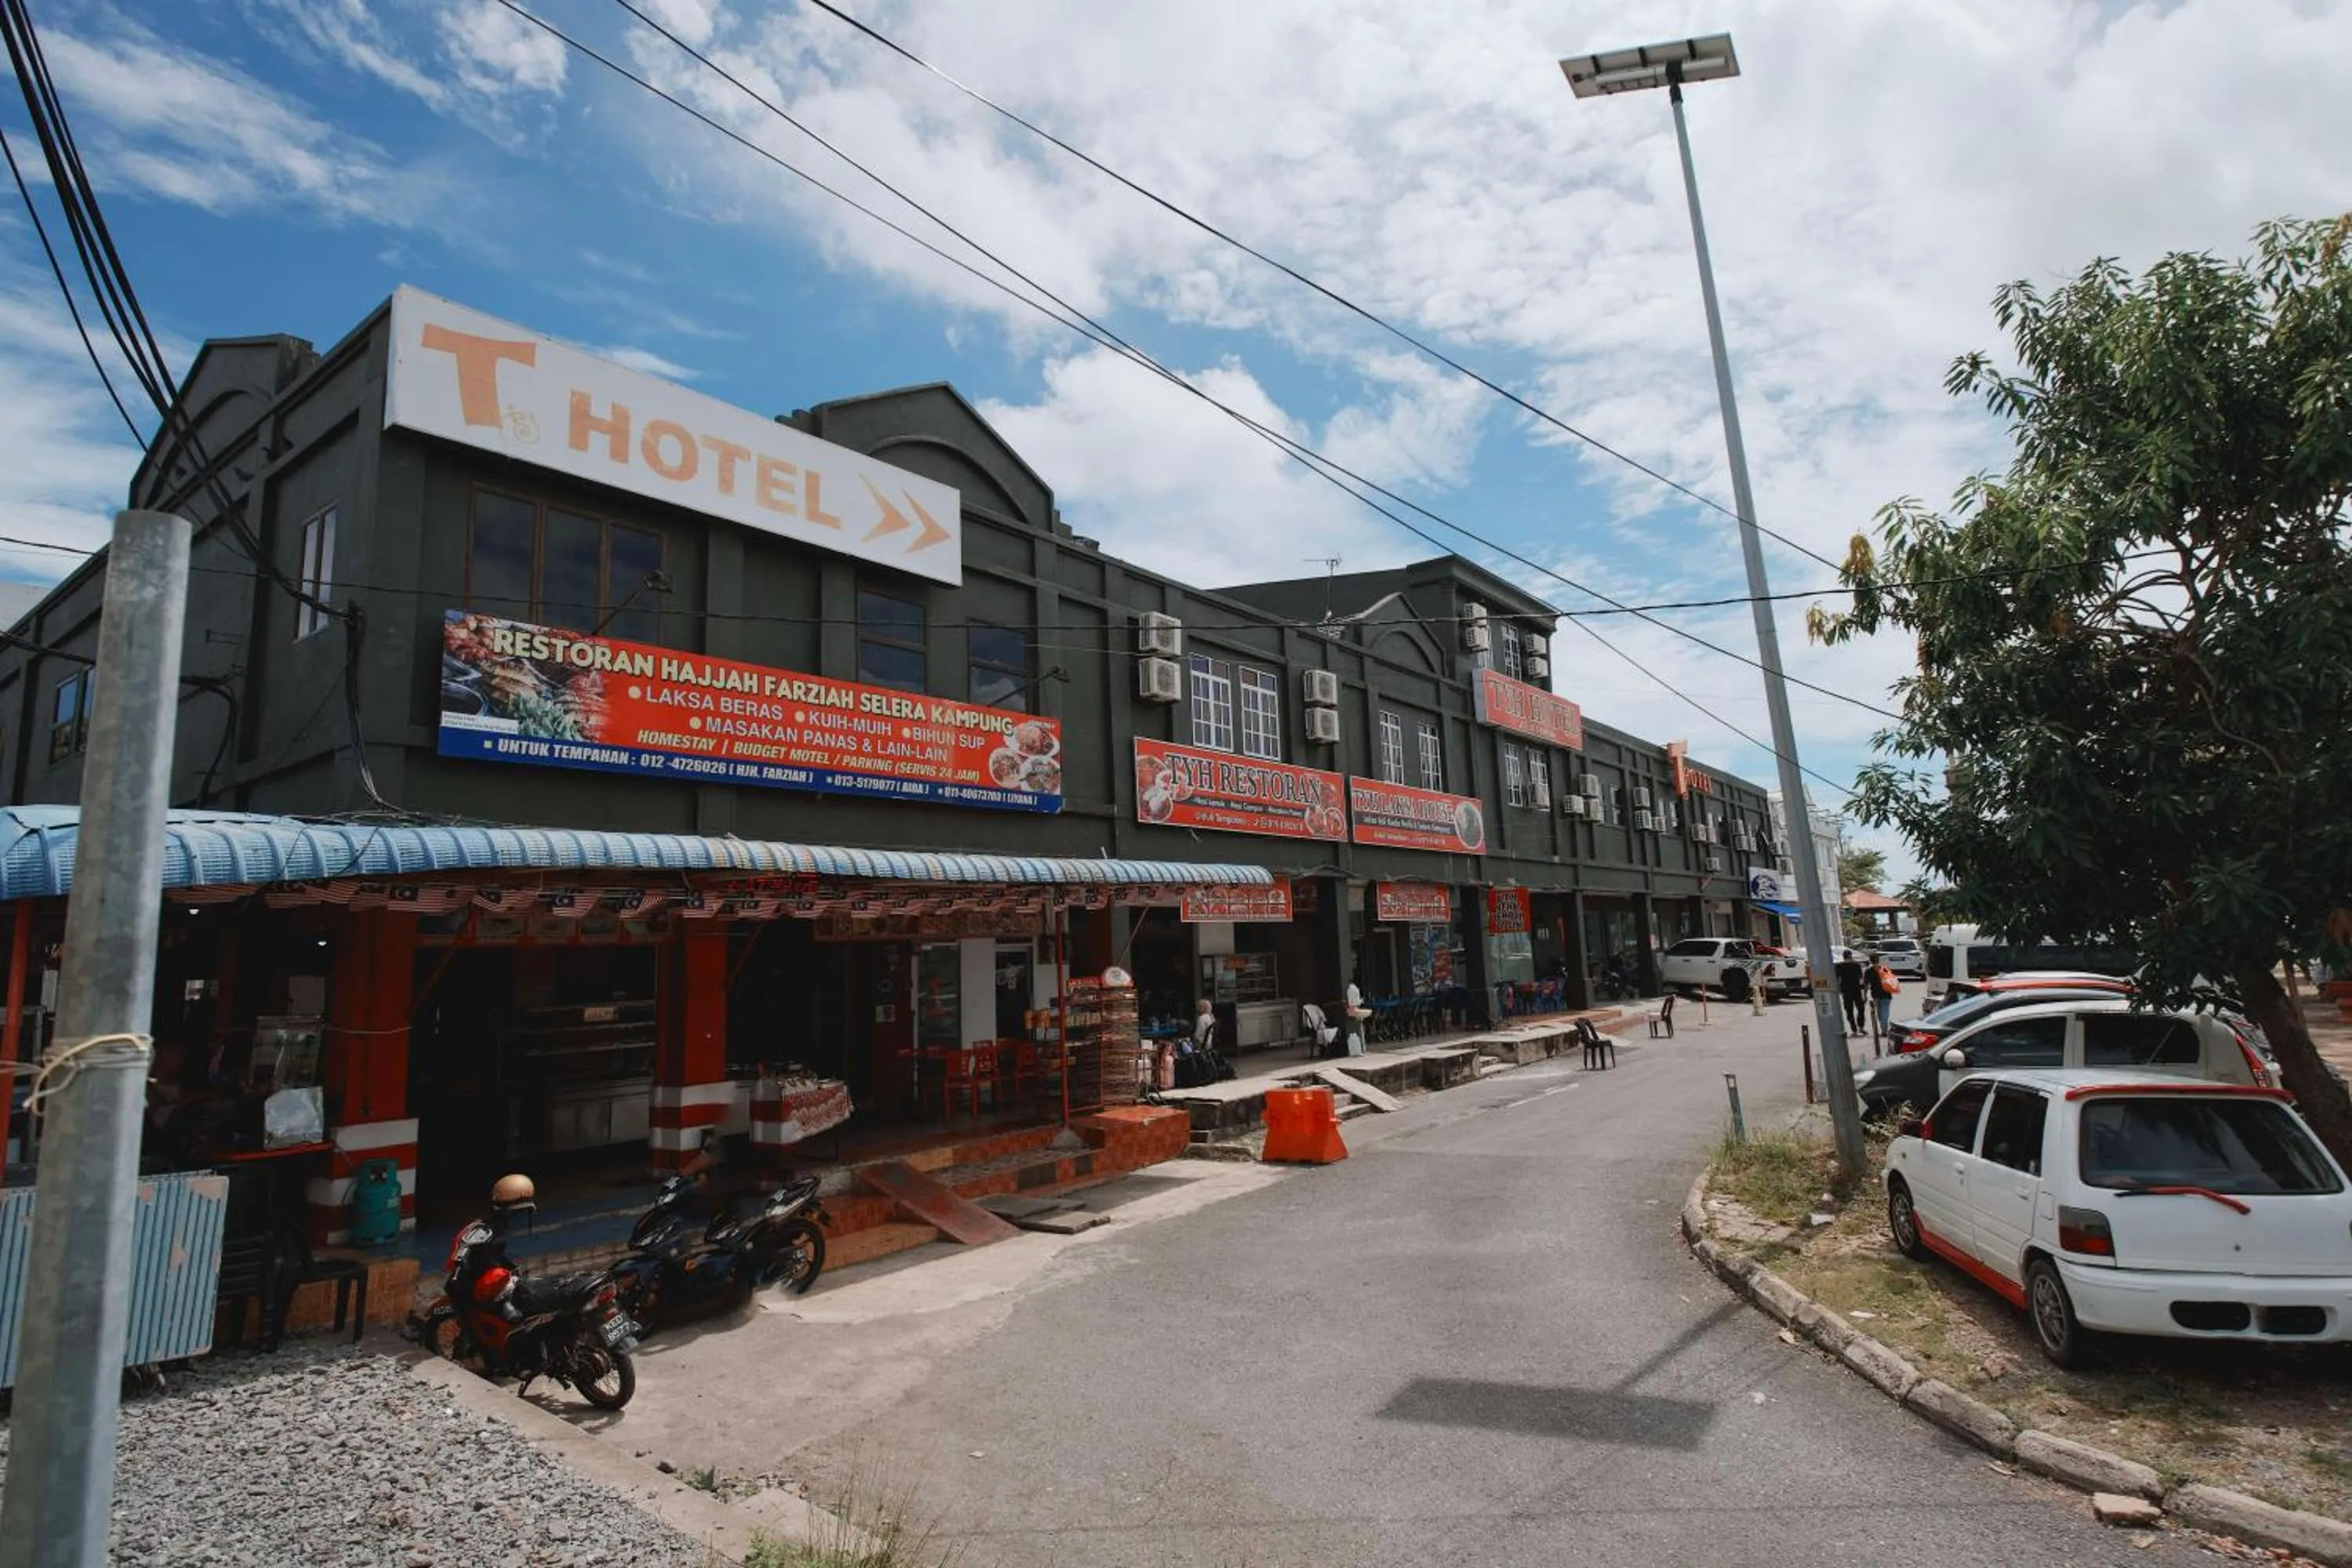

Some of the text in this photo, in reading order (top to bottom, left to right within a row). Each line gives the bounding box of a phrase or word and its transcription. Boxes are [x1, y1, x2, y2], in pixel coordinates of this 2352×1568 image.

[420, 323, 842, 531] T HOTEL
[492, 628, 1014, 737] RESTORAN HAJJAH FARZIAH SELERA KAMPUNG
[646, 685, 782, 721] LAKSA BERAS
[706, 716, 949, 764] MASAKAN PANAS & LAIN-LAIN
[808, 710, 891, 736] KUIH-MUIH
[912, 726, 985, 750] BIHUN SUP
[498, 738, 550, 757] UNTUK
[637, 729, 717, 752] HOMESTAY
[733, 741, 788, 760] BUDGET
[789, 748, 831, 765] MOTEL
[841, 755, 893, 773] PARKING
[1165, 753, 1322, 804] TYH RESTORAN
